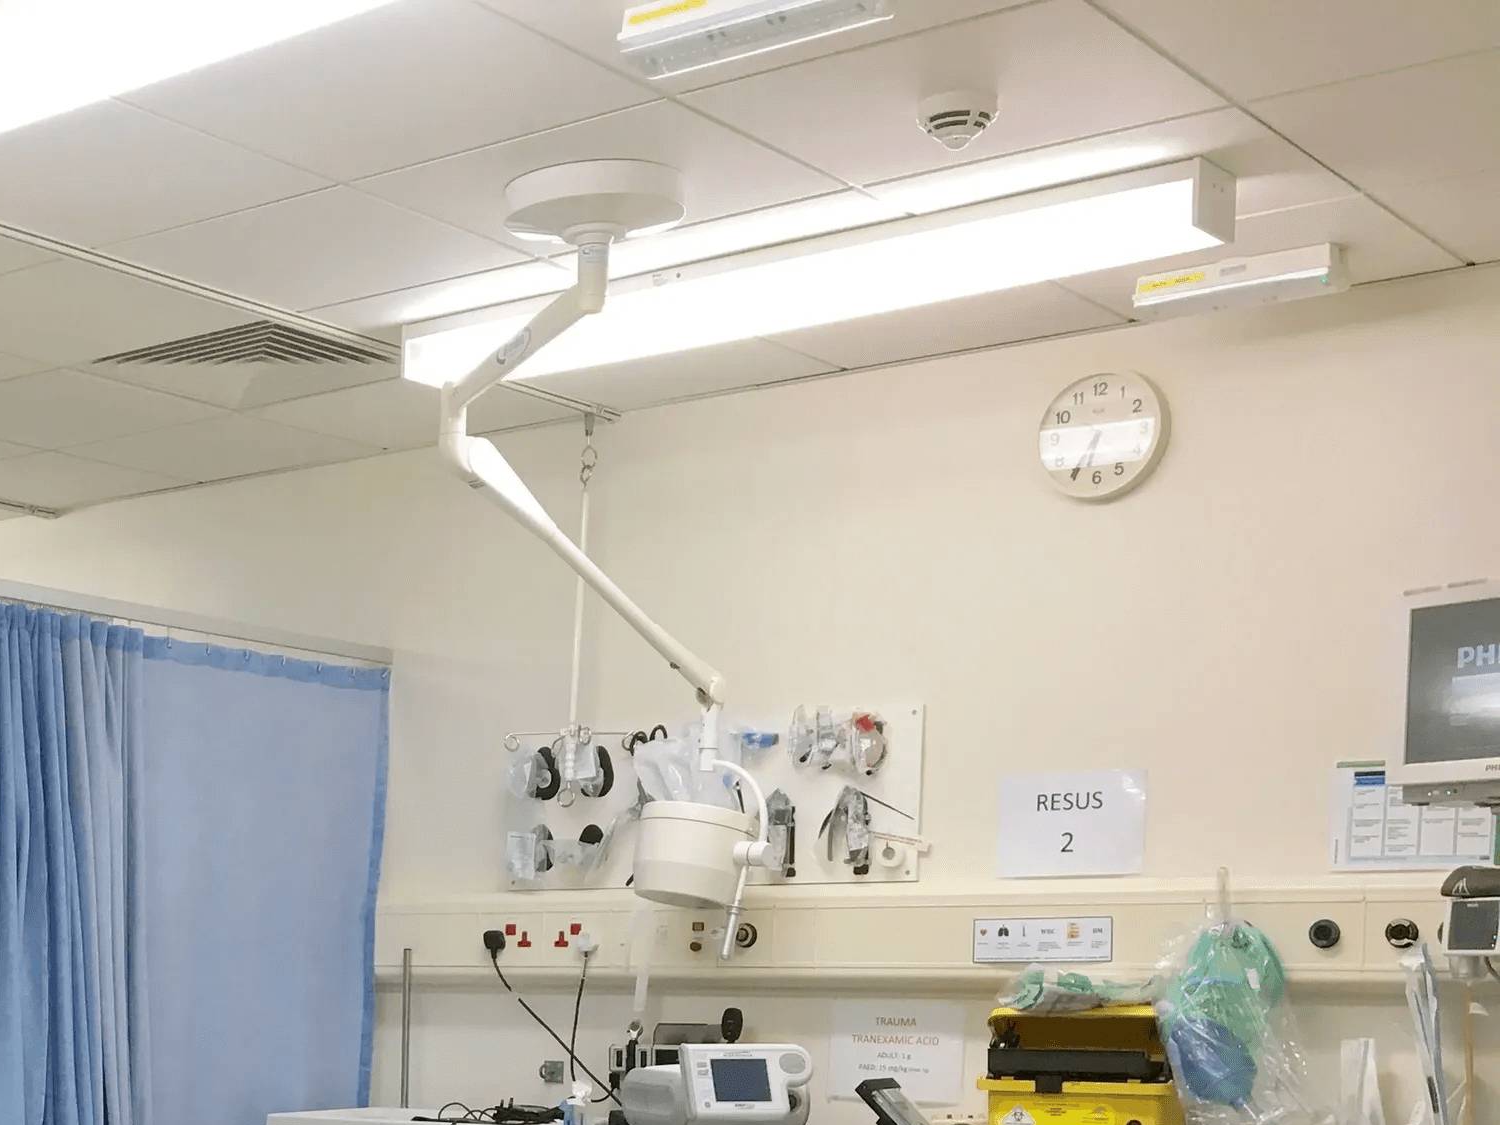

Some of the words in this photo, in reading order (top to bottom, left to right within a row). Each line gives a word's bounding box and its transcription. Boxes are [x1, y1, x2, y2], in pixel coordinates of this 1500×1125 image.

[1093, 382, 1108, 396] 12
[1120, 385, 1125, 399] 1
[1073, 391, 1084, 405] 11
[1132, 398, 1142, 413] 2
[1055, 410, 1071, 424] 10
[1114, 462, 1124, 476] 5
[1092, 471, 1102, 484] 6
[1457, 643, 1500, 669] PH
[1036, 791, 1103, 811] RESUS
[1060, 831, 1074, 852] 2
[875, 1016, 917, 1026] TRAUMA
[851, 1033, 915, 1045] TRANEXAMIC
[916, 1036, 939, 1046] ACID
